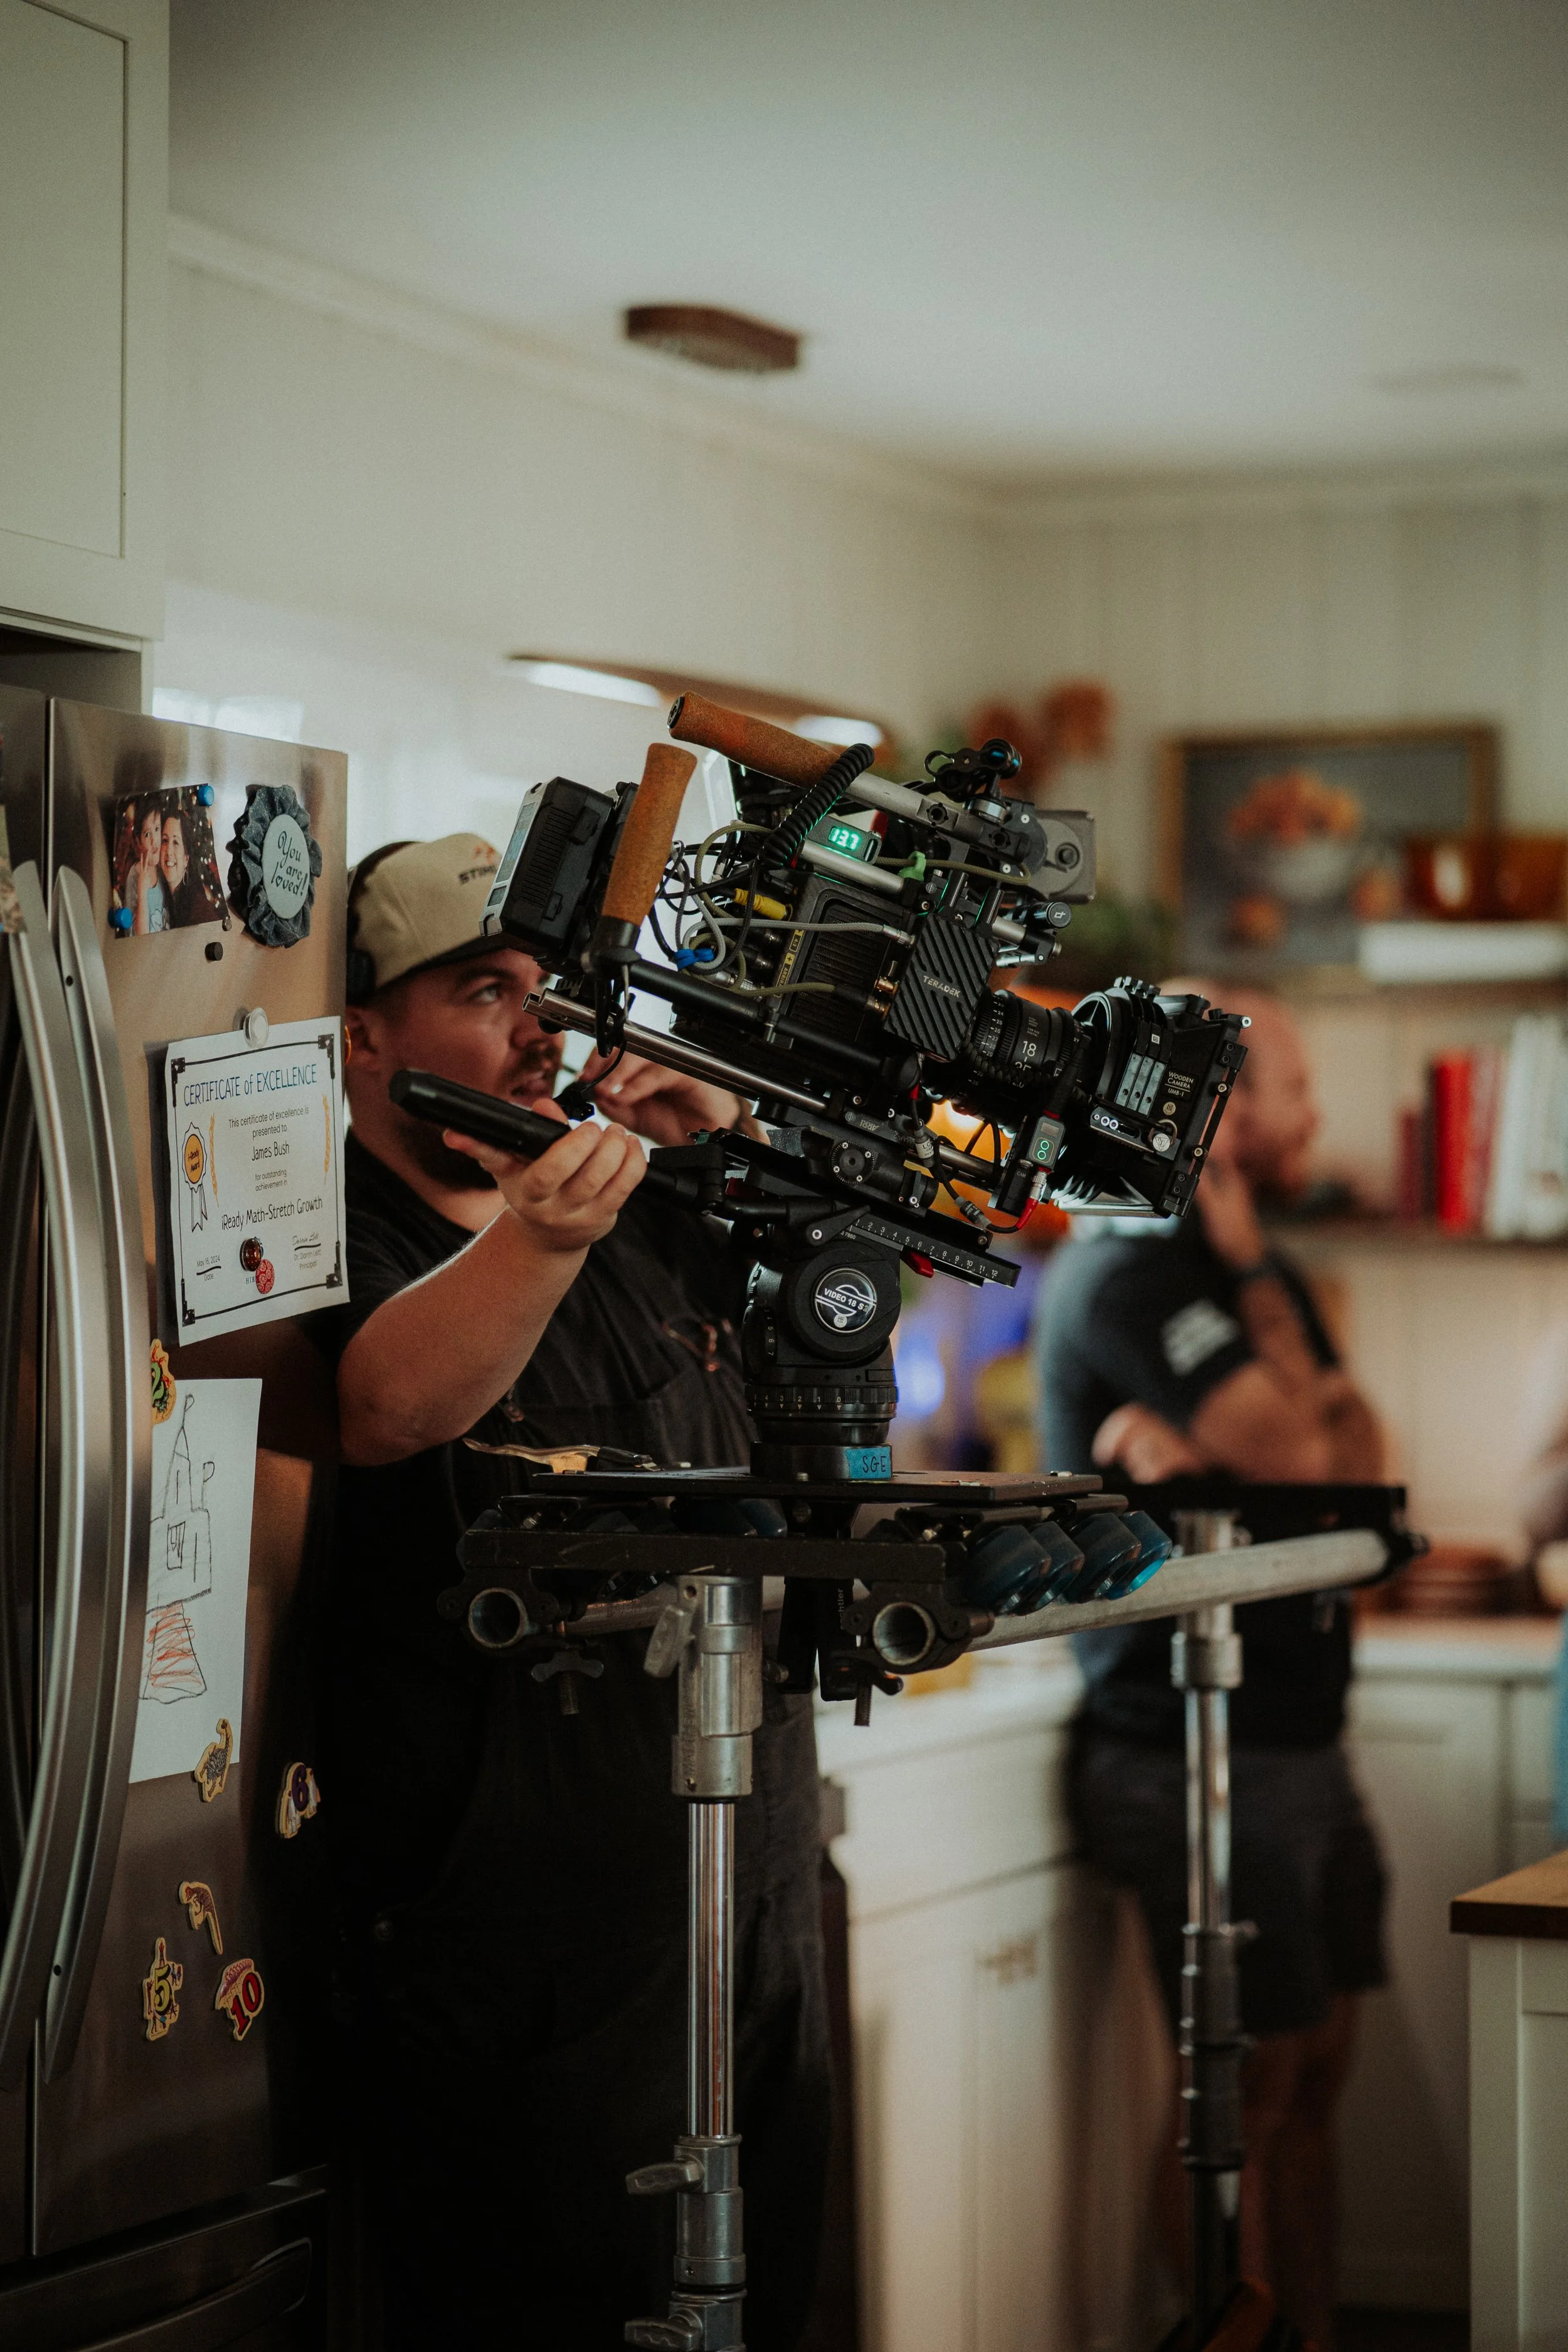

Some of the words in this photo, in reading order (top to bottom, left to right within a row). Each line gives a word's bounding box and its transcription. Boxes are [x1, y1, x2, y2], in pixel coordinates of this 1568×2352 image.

[278, 830, 301, 869] You
[286, 866, 302, 880] are
[778, 967, 789, 987] ARRIRA
[923, 975, 961, 998] TERADEK
[1022, 1041, 1037, 1057] 18
[184, 1076, 241, 1107] CERTIFICATE
[244, 1074, 253, 1095] of
[257, 1064, 317, 1093] EXCELLENCE
[1167, 1078, 1190, 1089] CAMERA
[1168, 1071, 1194, 1084] WOODEN
[1168, 1088, 1184, 1097] UMB-1
[228, 1118, 239, 1128] This
[240, 1114, 268, 1126] certificate
[269, 1111, 275, 1121] of
[276, 1108, 304, 1120] excellence
[859, 1119, 879, 1131] ARRI
[252, 1124, 280, 1140] presented
[281, 1124, 287, 1133] to
[252, 1146, 272, 1161] James
[273, 1141, 290, 1157] Bush
[262, 1169, 287, 1180] outstanding
[255, 1180, 283, 1191] achievement
[221, 1210, 244, 1232] iReady
[246, 1202, 295, 1224] Math-Stretch
[297, 1195, 323, 1214] Growth
[211, 1254, 220, 1264] 2024
[824, 1288, 847, 1303] VIDEO
[848, 1298, 857, 1307] 18
[862, 1455, 886, 1473] SGE
[292, 1764, 307, 1811] 6
[154, 1964, 171, 2016] 5
[231, 1971, 261, 2037] 10
